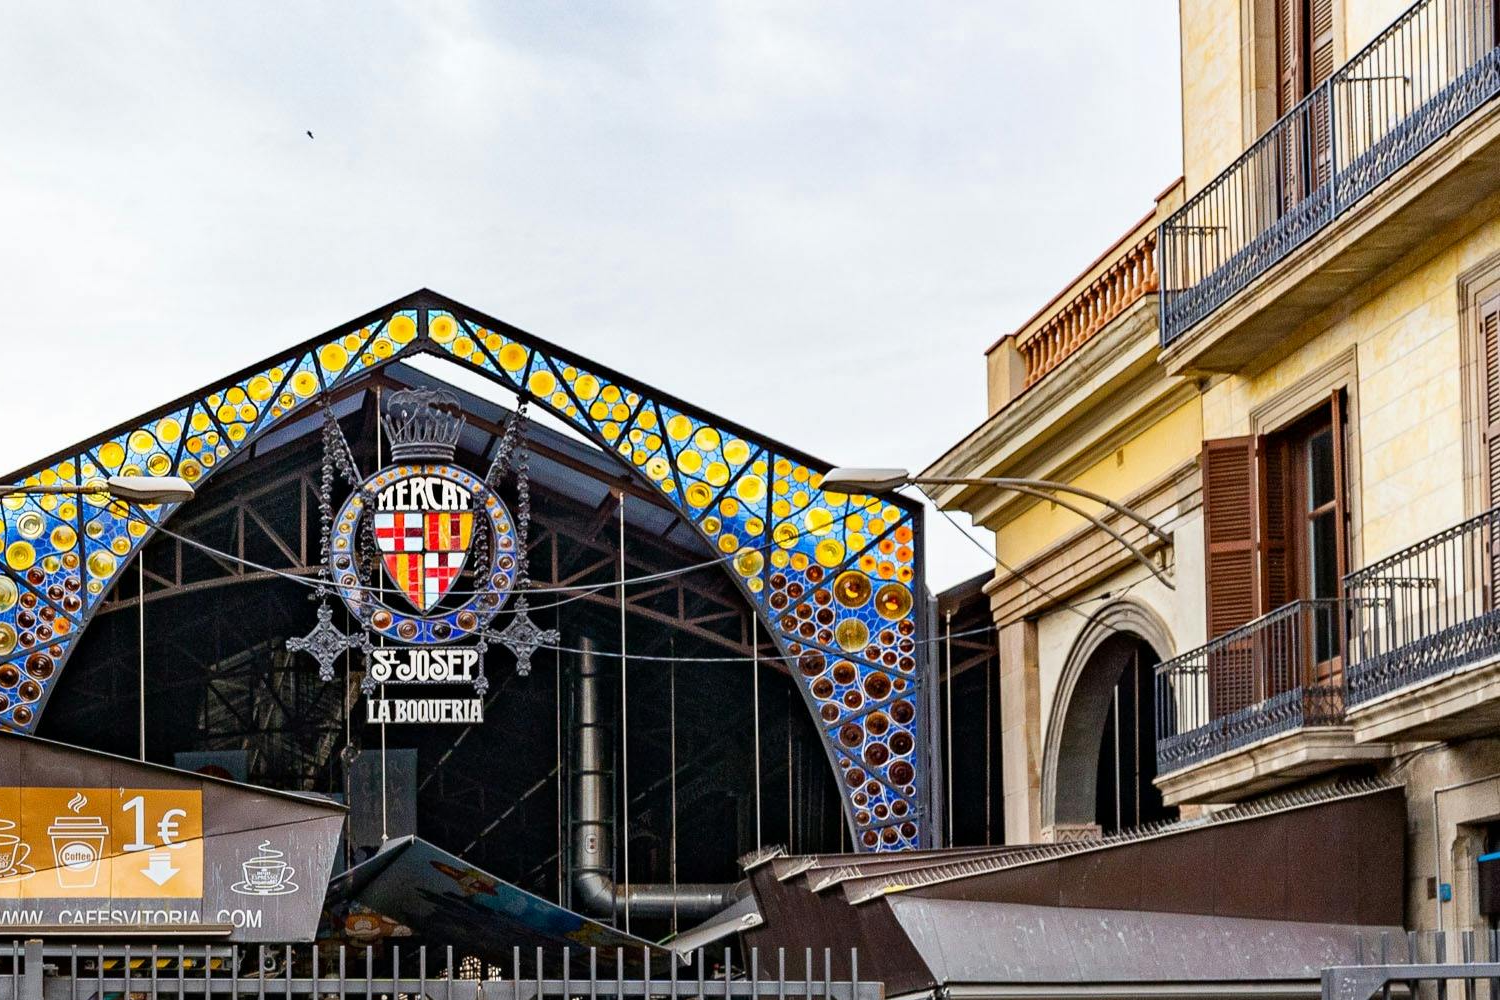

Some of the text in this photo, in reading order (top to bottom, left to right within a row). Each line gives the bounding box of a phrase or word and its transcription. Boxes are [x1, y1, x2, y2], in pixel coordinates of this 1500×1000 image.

[377, 477, 471, 511] MERCAT
[396, 649, 479, 681] JOSEP
[367, 699, 484, 723] LA BOQUERIA
[64, 851, 91, 862] Coffee
